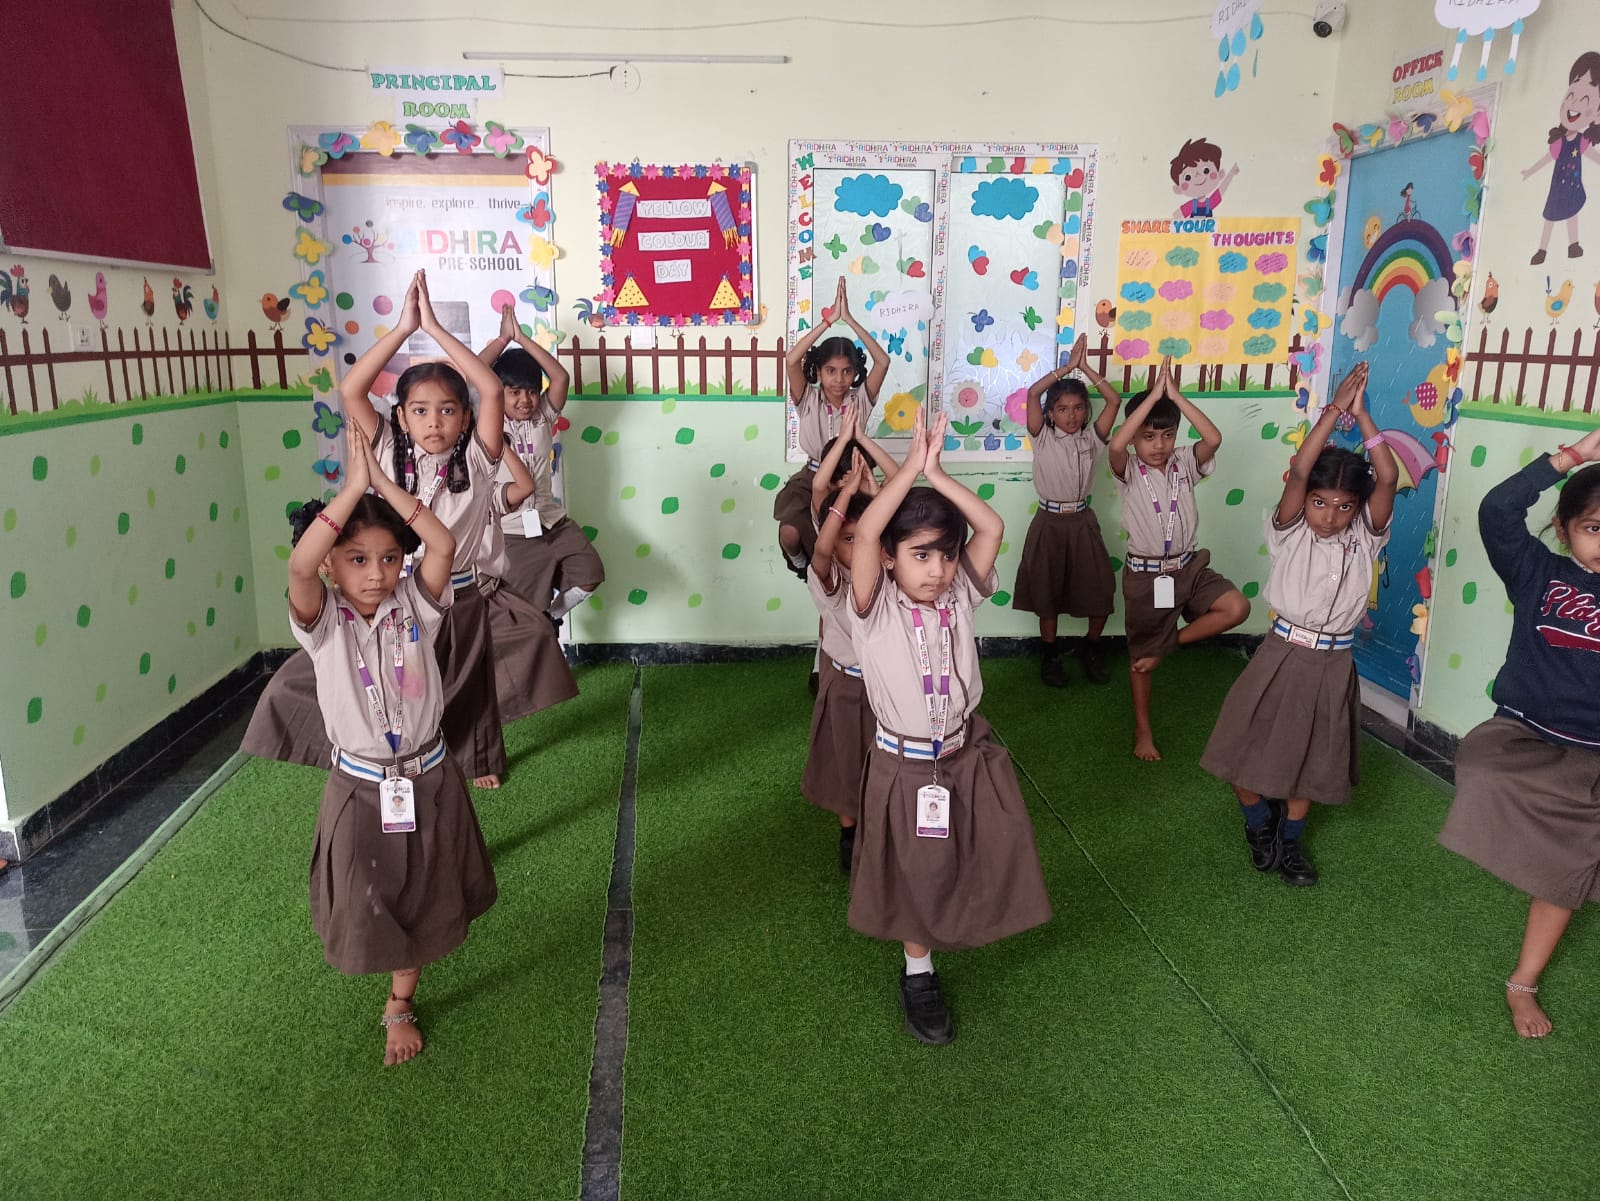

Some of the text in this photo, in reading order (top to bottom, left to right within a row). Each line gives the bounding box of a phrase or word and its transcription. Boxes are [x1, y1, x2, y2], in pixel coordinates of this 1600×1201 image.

[1392, 50, 1443, 83] OFFICE
[371, 73, 497, 91] PRINCIPAL
[1393, 78, 1434, 104] ROOM
[403, 102, 471, 119] ROOM
[641, 201, 710, 216] YELLOW
[1121, 219, 1215, 234] SHARE YOUR
[640, 232, 707, 249] COLOUR
[1212, 231, 1294, 247] THOUGHTS
[656, 262, 689, 278] DAY
